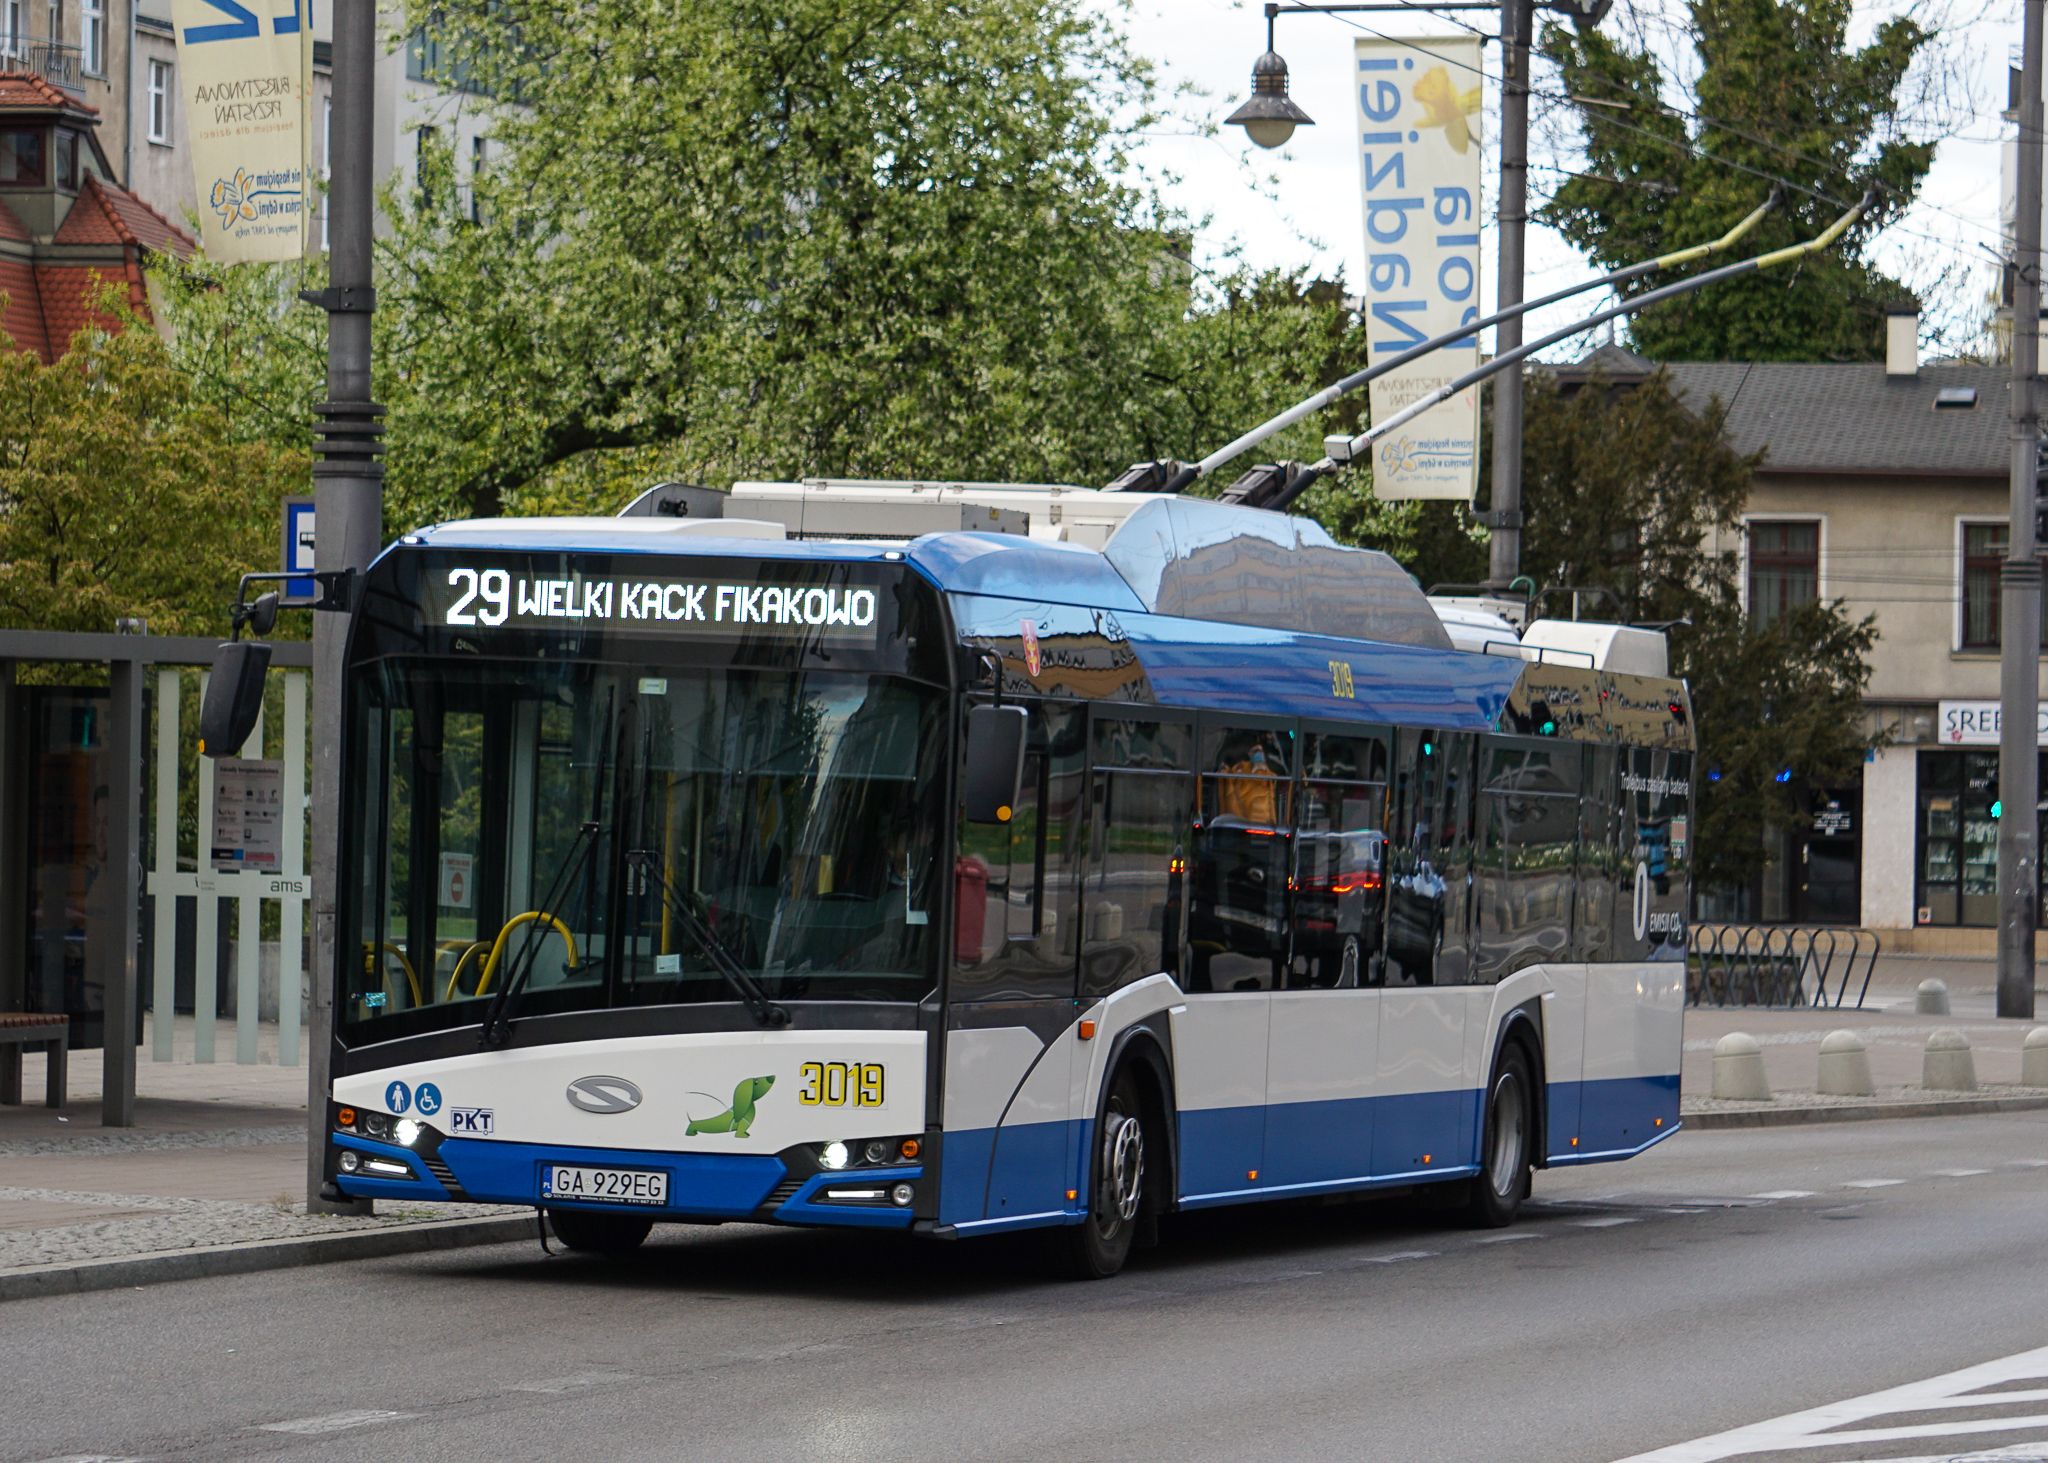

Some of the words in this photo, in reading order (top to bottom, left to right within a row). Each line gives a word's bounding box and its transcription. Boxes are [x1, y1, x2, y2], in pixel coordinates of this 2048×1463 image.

[446, 568, 510, 626] 29
[517, 579, 613, 618] WIELKI
[620, 582, 706, 621] KACK
[715, 585, 874, 626] FIKAKOWO
[1328, 660, 1355, 699] 3019
[270, 880, 303, 893] ams
[799, 1062, 885, 1108] 3019
[453, 1108, 491, 1131] PKT
[557, 1169, 584, 1193] GA
[594, 1171, 661, 1198] 929EG
